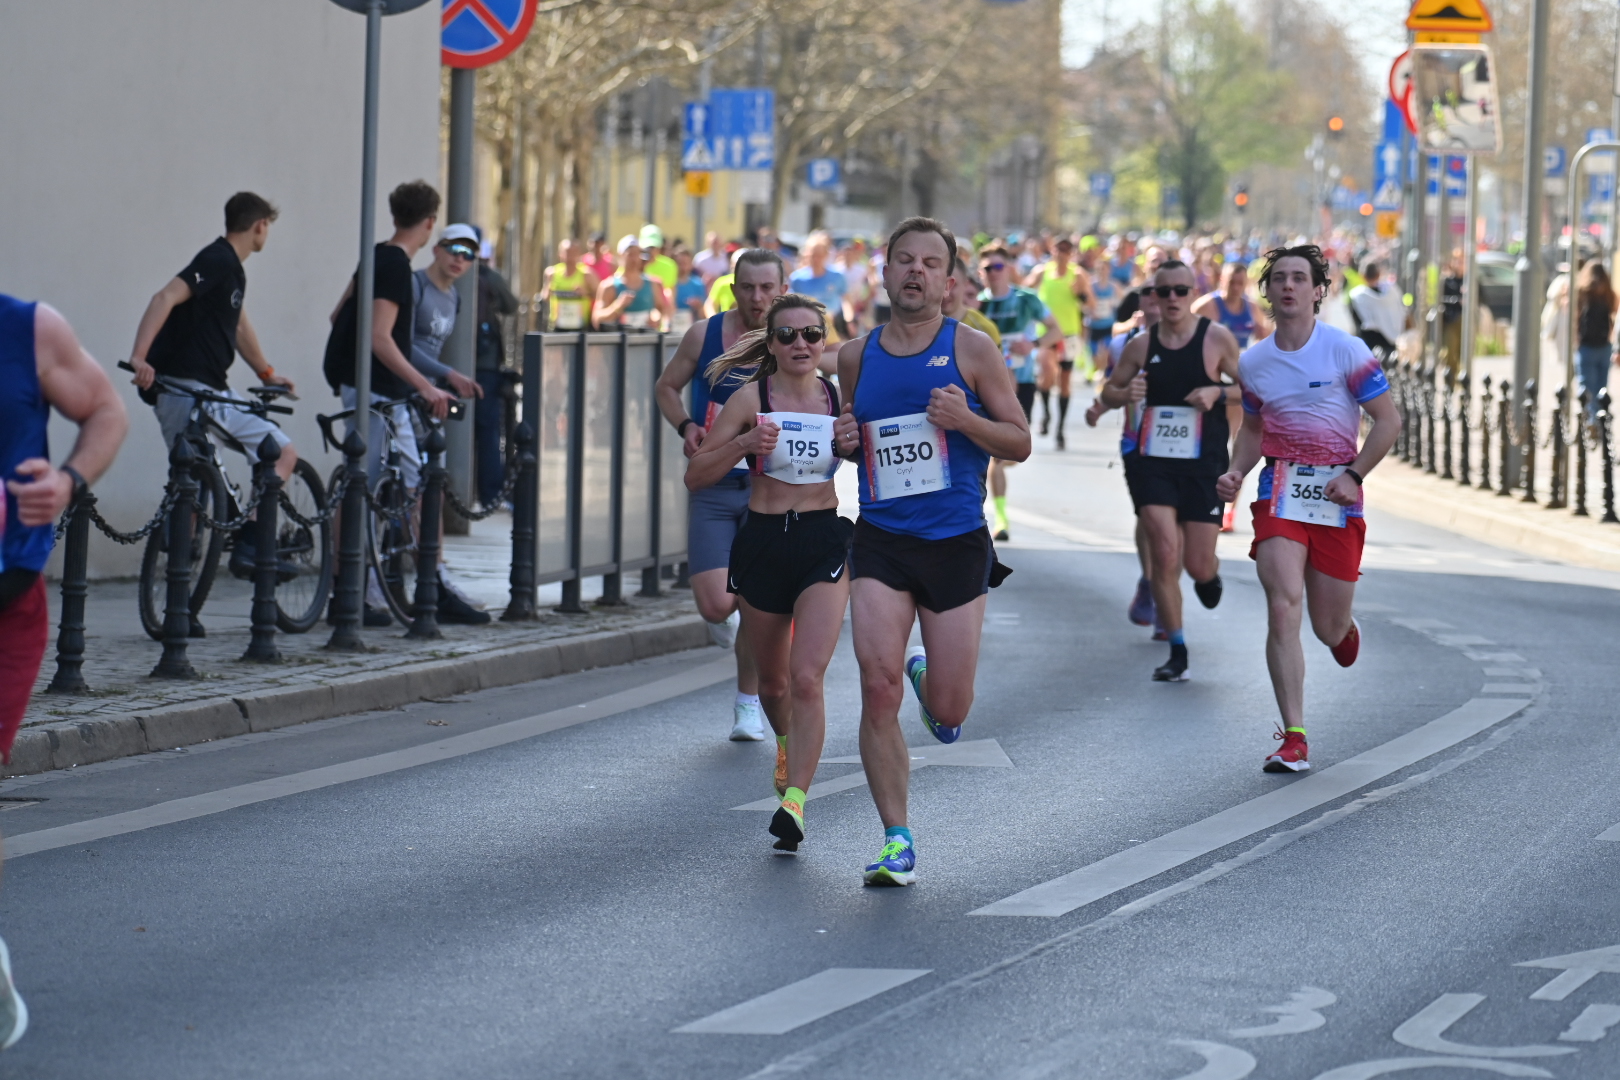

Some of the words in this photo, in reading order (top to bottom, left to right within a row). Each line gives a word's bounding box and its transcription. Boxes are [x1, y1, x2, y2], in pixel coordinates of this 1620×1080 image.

[1156, 425, 1188, 438] 7268
[786, 440, 819, 458] 195
[876, 441, 933, 467] 11330
[896, 466, 914, 475] Cyryl
